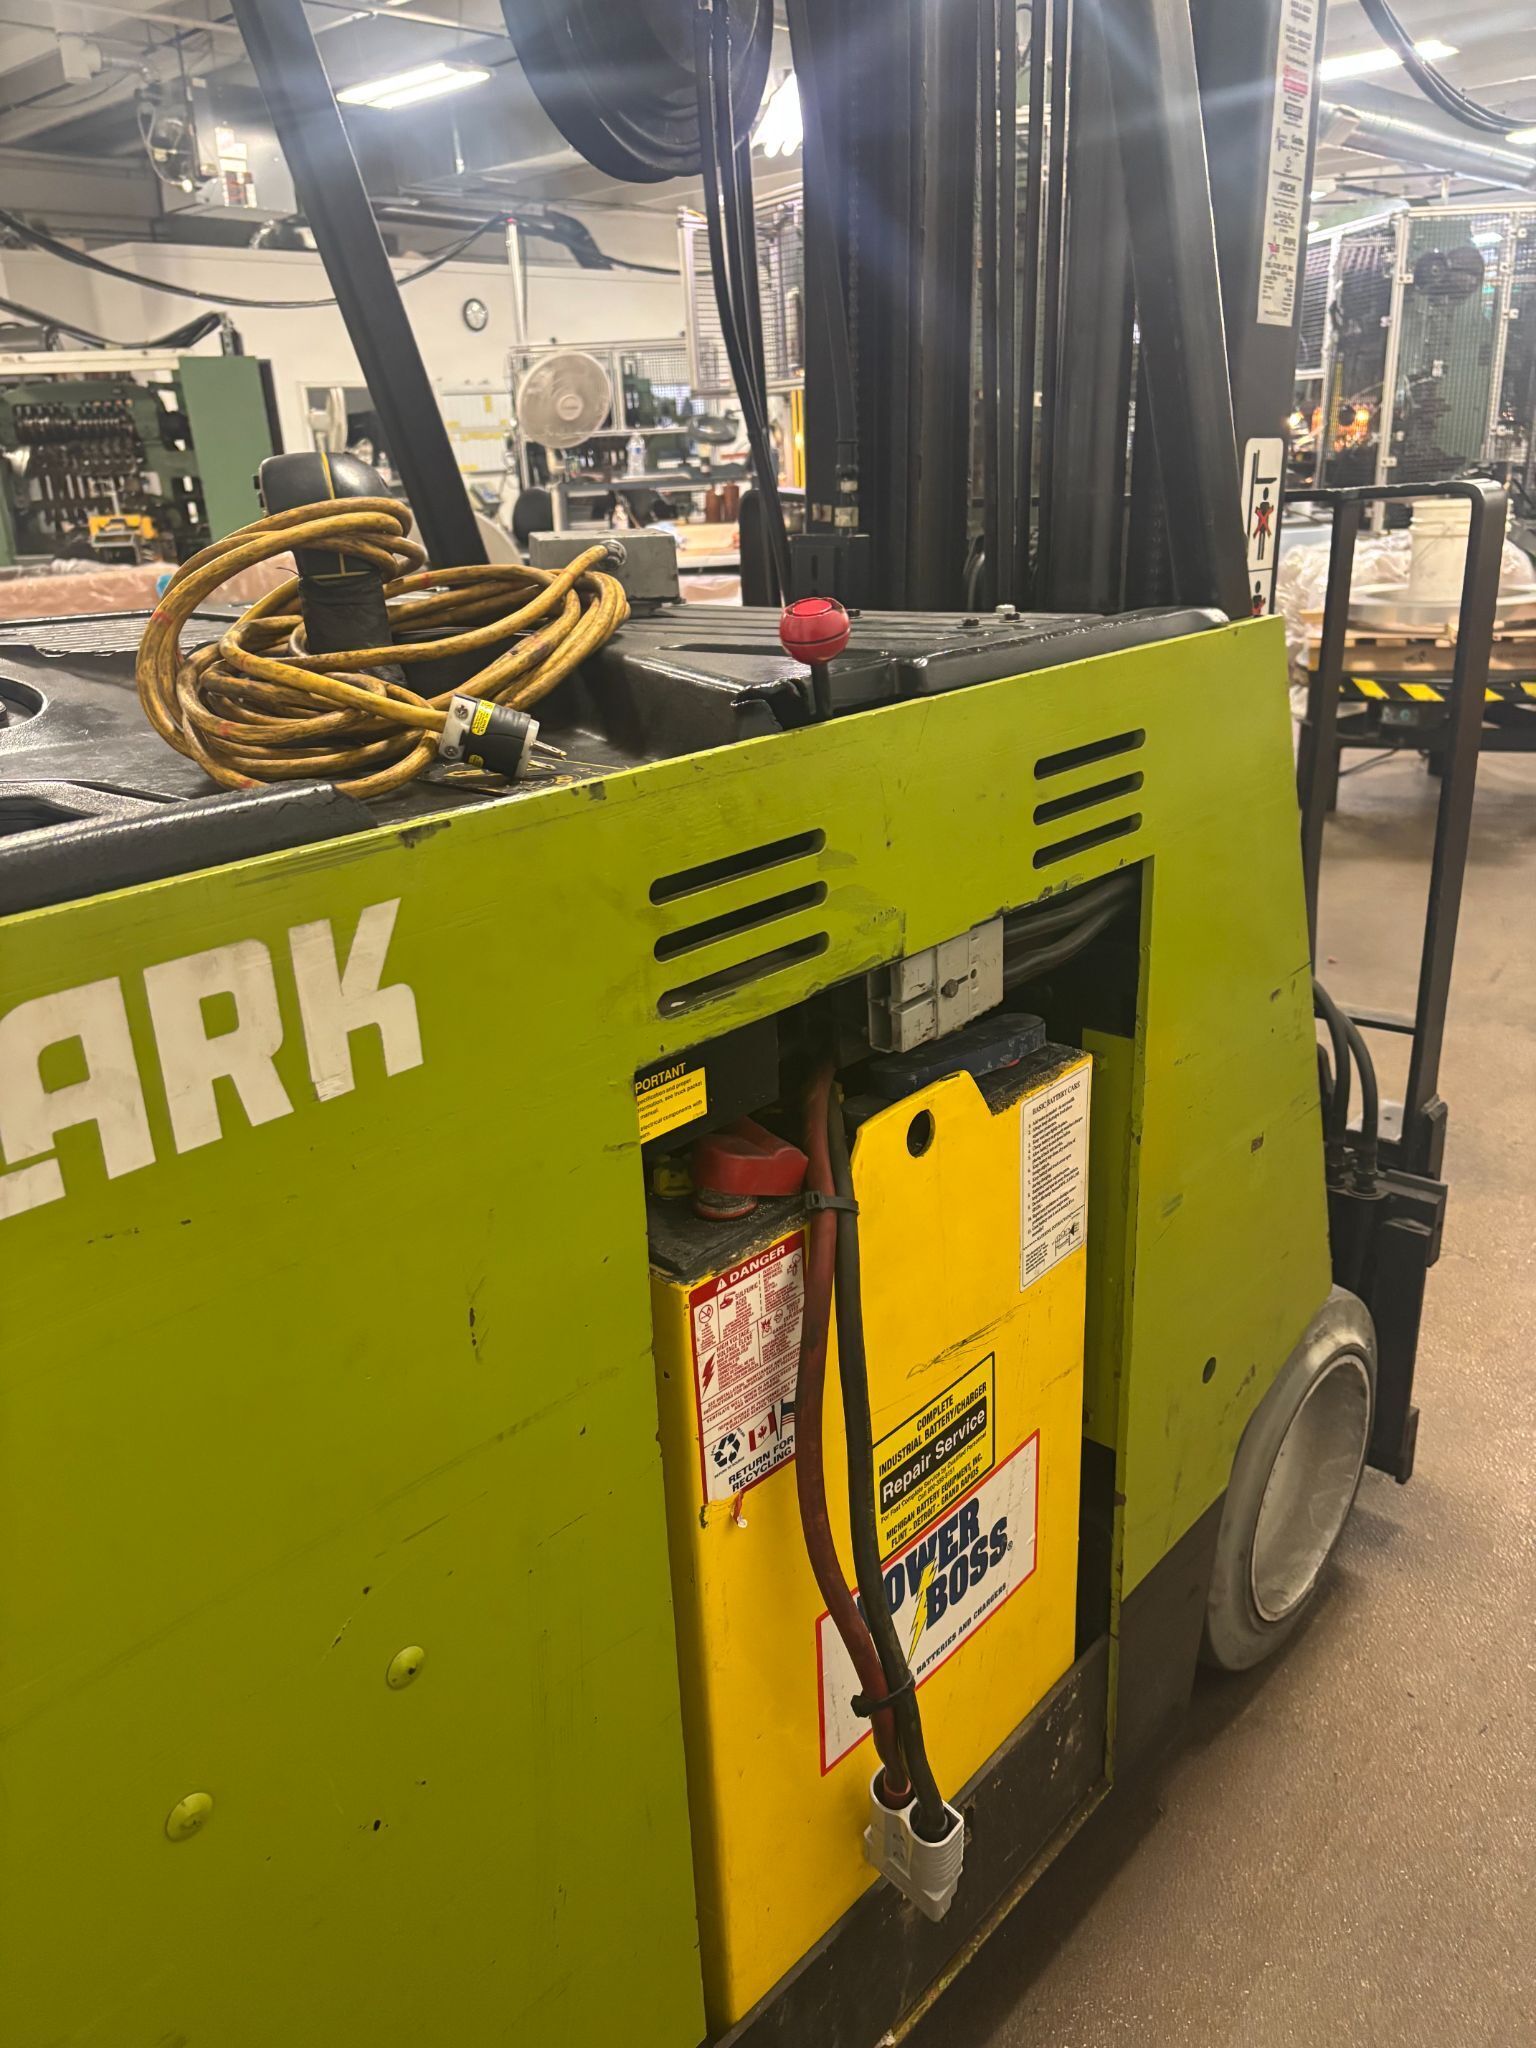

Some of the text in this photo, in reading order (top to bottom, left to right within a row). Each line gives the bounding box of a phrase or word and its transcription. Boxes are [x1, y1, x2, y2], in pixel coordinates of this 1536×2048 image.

[635, 1062, 686, 1095] PORTANT
[1047, 1088, 1068, 1108] BATTERY
[729, 1245, 786, 1284] DANGER
[879, 1381, 987, 1477] INDUSTRIAL BATTERY/CHARGER
[916, 1394, 954, 1431] COMPLETE
[728, 1435, 794, 1485] RETURN FOR
[732, 1446, 792, 1493] RECYCLING
[883, 1408, 985, 1504] Repair Service
[880, 1513, 890, 1524] For
[890, 1506, 901, 1516] Fast
[901, 1488, 924, 1507] Complete
[924, 1471, 941, 1489] Service
[886, 1453, 983, 1540] MICHIGAN BATTERY EQUIPMENT, INC.
[892, 1530, 908, 1548] FLINT
[913, 1505, 936, 1530] DETROIT
[941, 1484, 960, 1505] GRAND
[960, 1466, 979, 1489] RAPIDS
[857, 1497, 979, 1634] OWER
[926, 1516, 1008, 1631] BOSS
[916, 1582, 1007, 1676] BATTERIES AND CHARGERS
